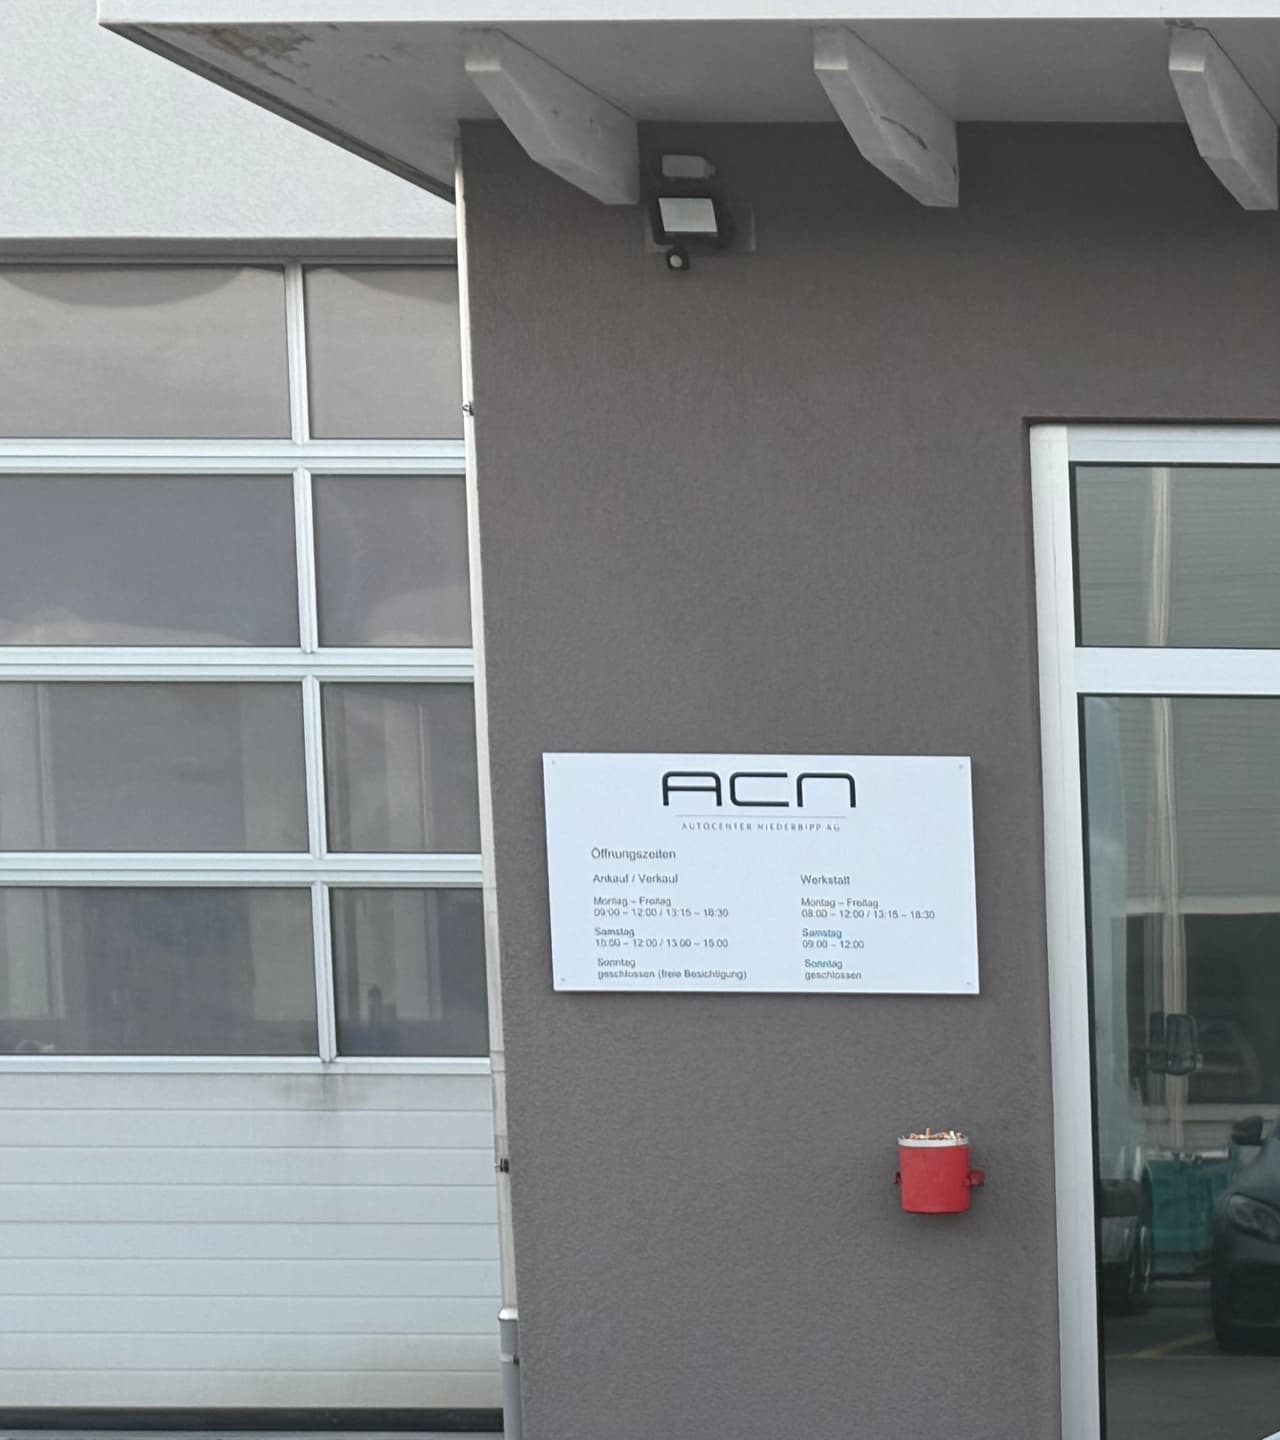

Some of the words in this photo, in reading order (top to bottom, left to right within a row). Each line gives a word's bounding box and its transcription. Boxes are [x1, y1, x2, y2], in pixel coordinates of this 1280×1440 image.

[662, 771, 856, 808] ACN
[681, 821, 752, 831] AUTOCENTER
[756, 822, 822, 832] NIEDERBIPP
[826, 823, 841, 832] AG
[590, 847, 677, 862] Öffnungszeiten
[592, 873, 629, 884] Ankauf
[637, 873, 679, 884] Verkauf
[799, 874, 851, 886] Werkstatt
[800, 897, 837, 909] Montag
[804, 971, 862, 981] geschlossen
